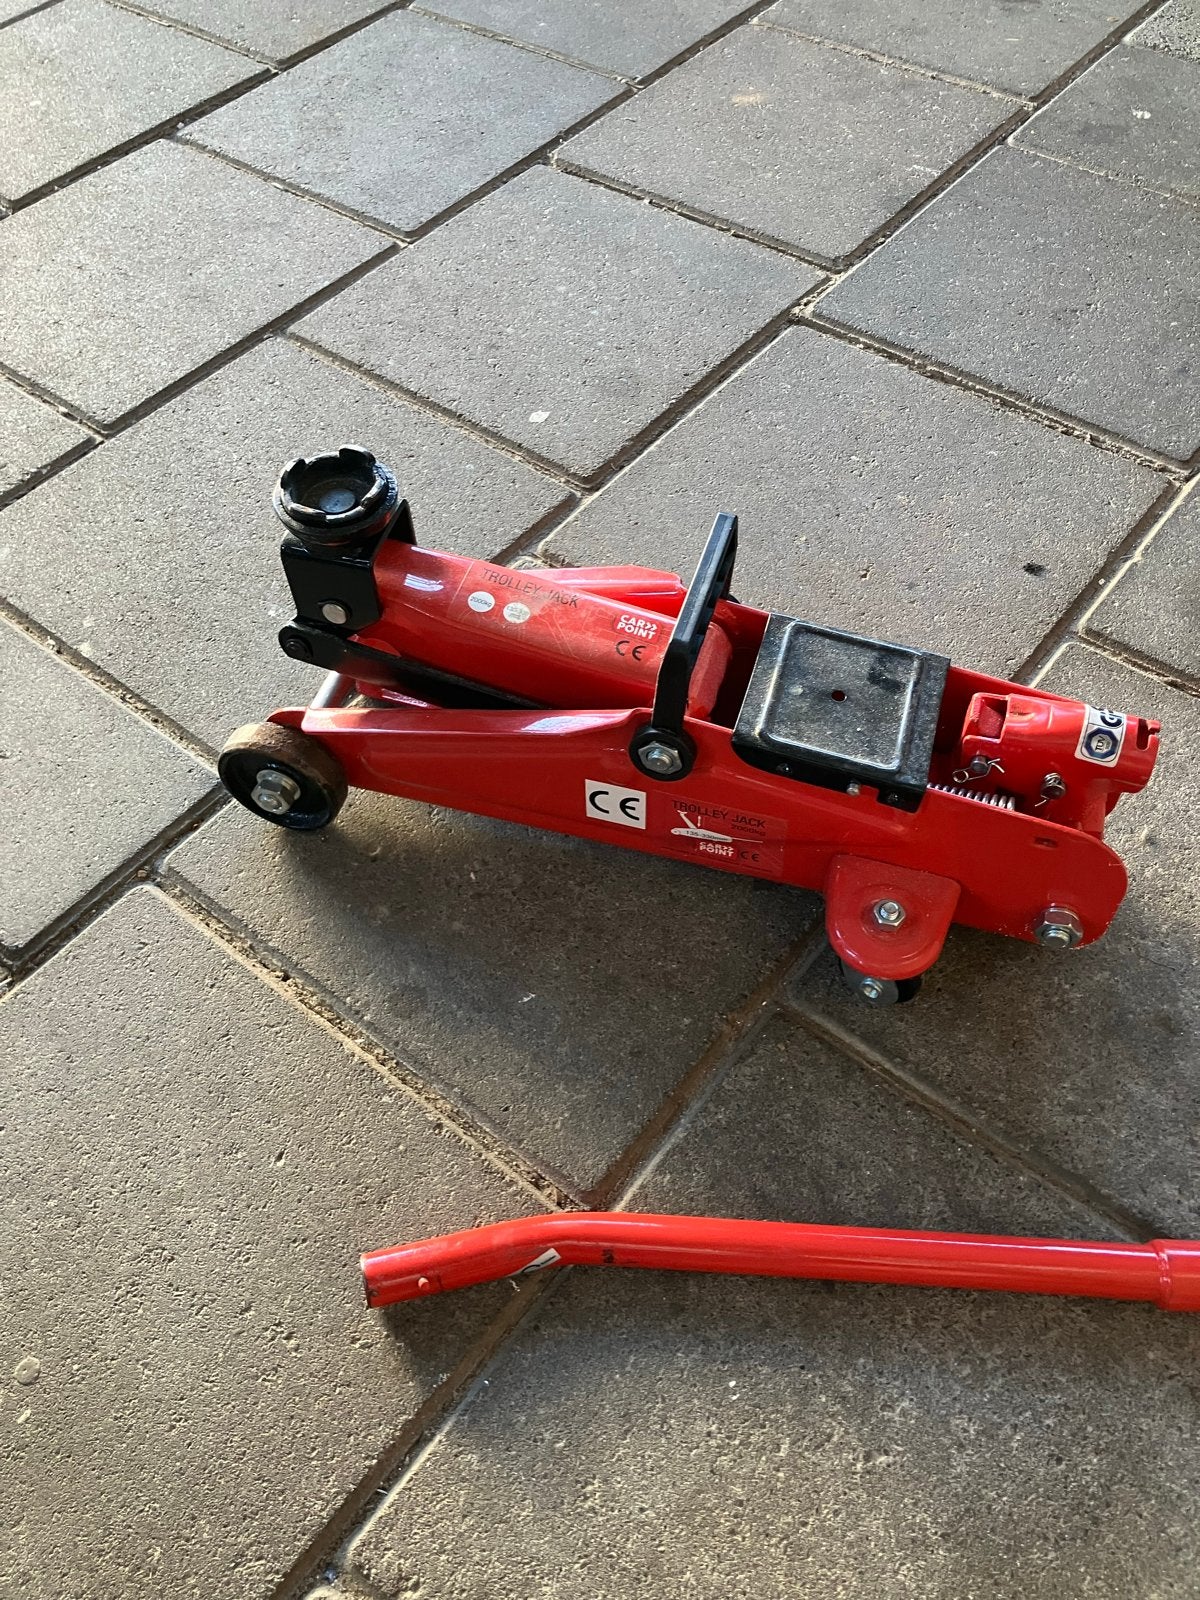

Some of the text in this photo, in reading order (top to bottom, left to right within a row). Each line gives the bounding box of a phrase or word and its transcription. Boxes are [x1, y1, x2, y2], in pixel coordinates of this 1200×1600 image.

[481, 568, 580, 608] TROLLEY JACK
[616, 621, 656, 640] POINT
[620, 614, 645, 628] CAR
[615, 640, 647, 662] CE
[589, 790, 640, 821] CE
[671, 800, 766, 829] TROLLEY JACK
[699, 845, 734, 857] POINT
[740, 851, 760, 862] CE
